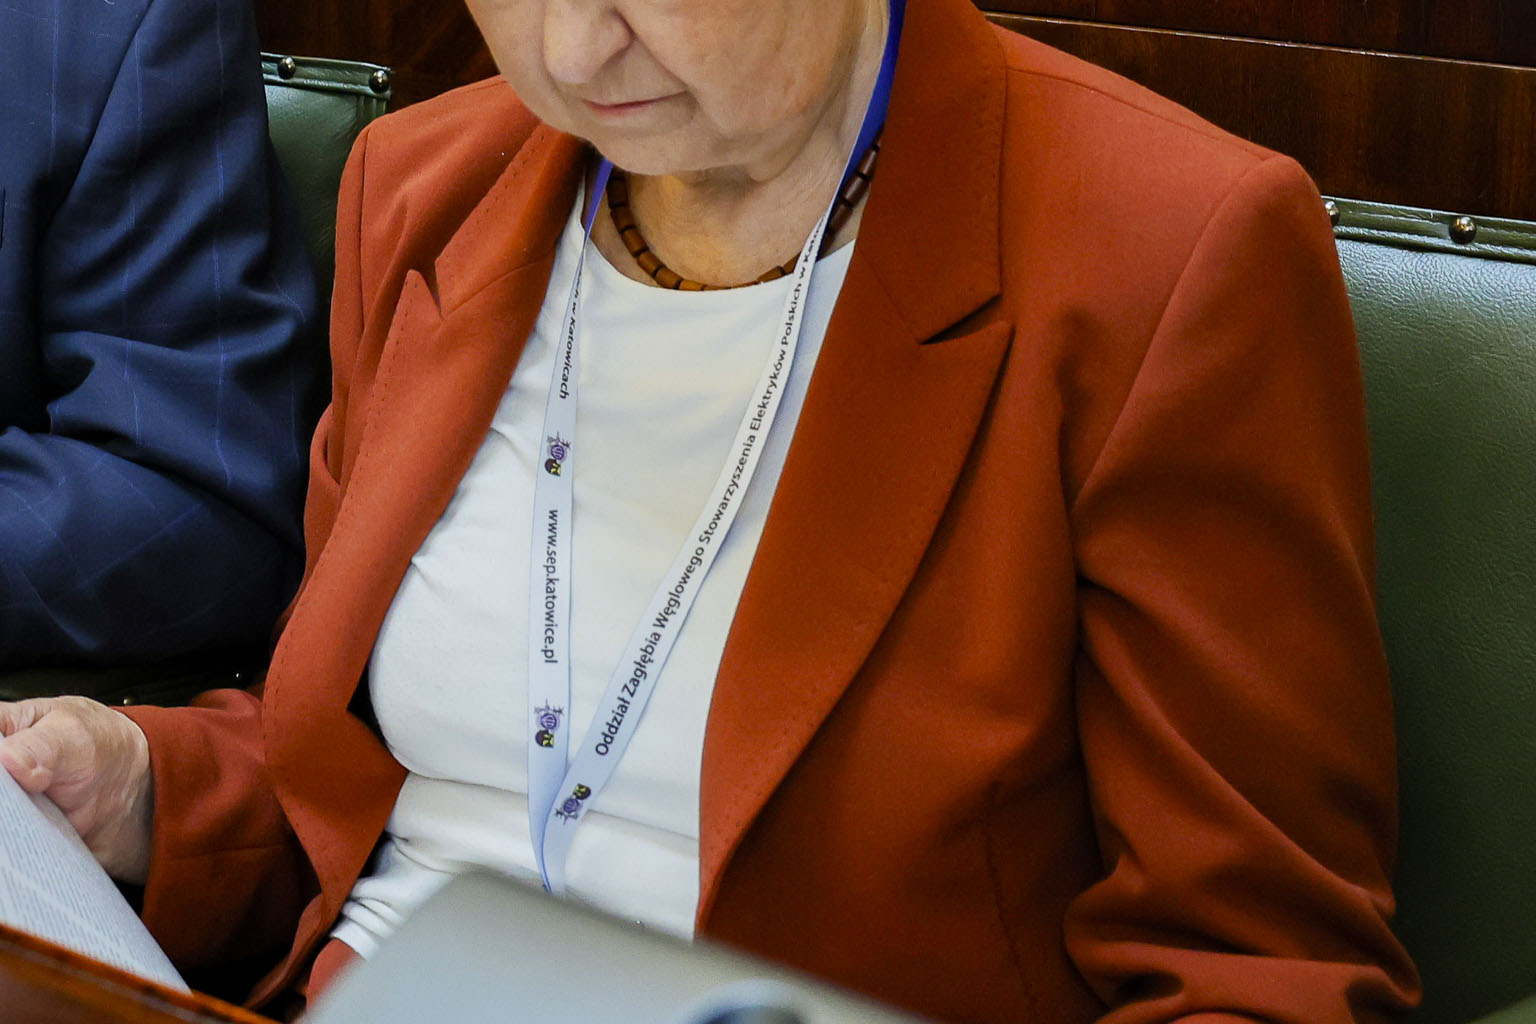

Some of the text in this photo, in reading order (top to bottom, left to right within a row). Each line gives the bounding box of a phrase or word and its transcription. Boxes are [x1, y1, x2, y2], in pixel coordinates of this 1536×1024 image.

[559, 317, 576, 399] Katowicach
[540, 509, 560, 664] www.sep.katowice.pl
[595, 696, 631, 756] Oddział
[621, 632, 661, 700] Zagłębia
[653, 546, 705, 629] Węglowego
[698, 433, 757, 545] Stowarzyszenia
[749, 349, 787, 432] Elektryków
[781, 283, 802, 345] Polskich
[799, 267, 806, 279] w
